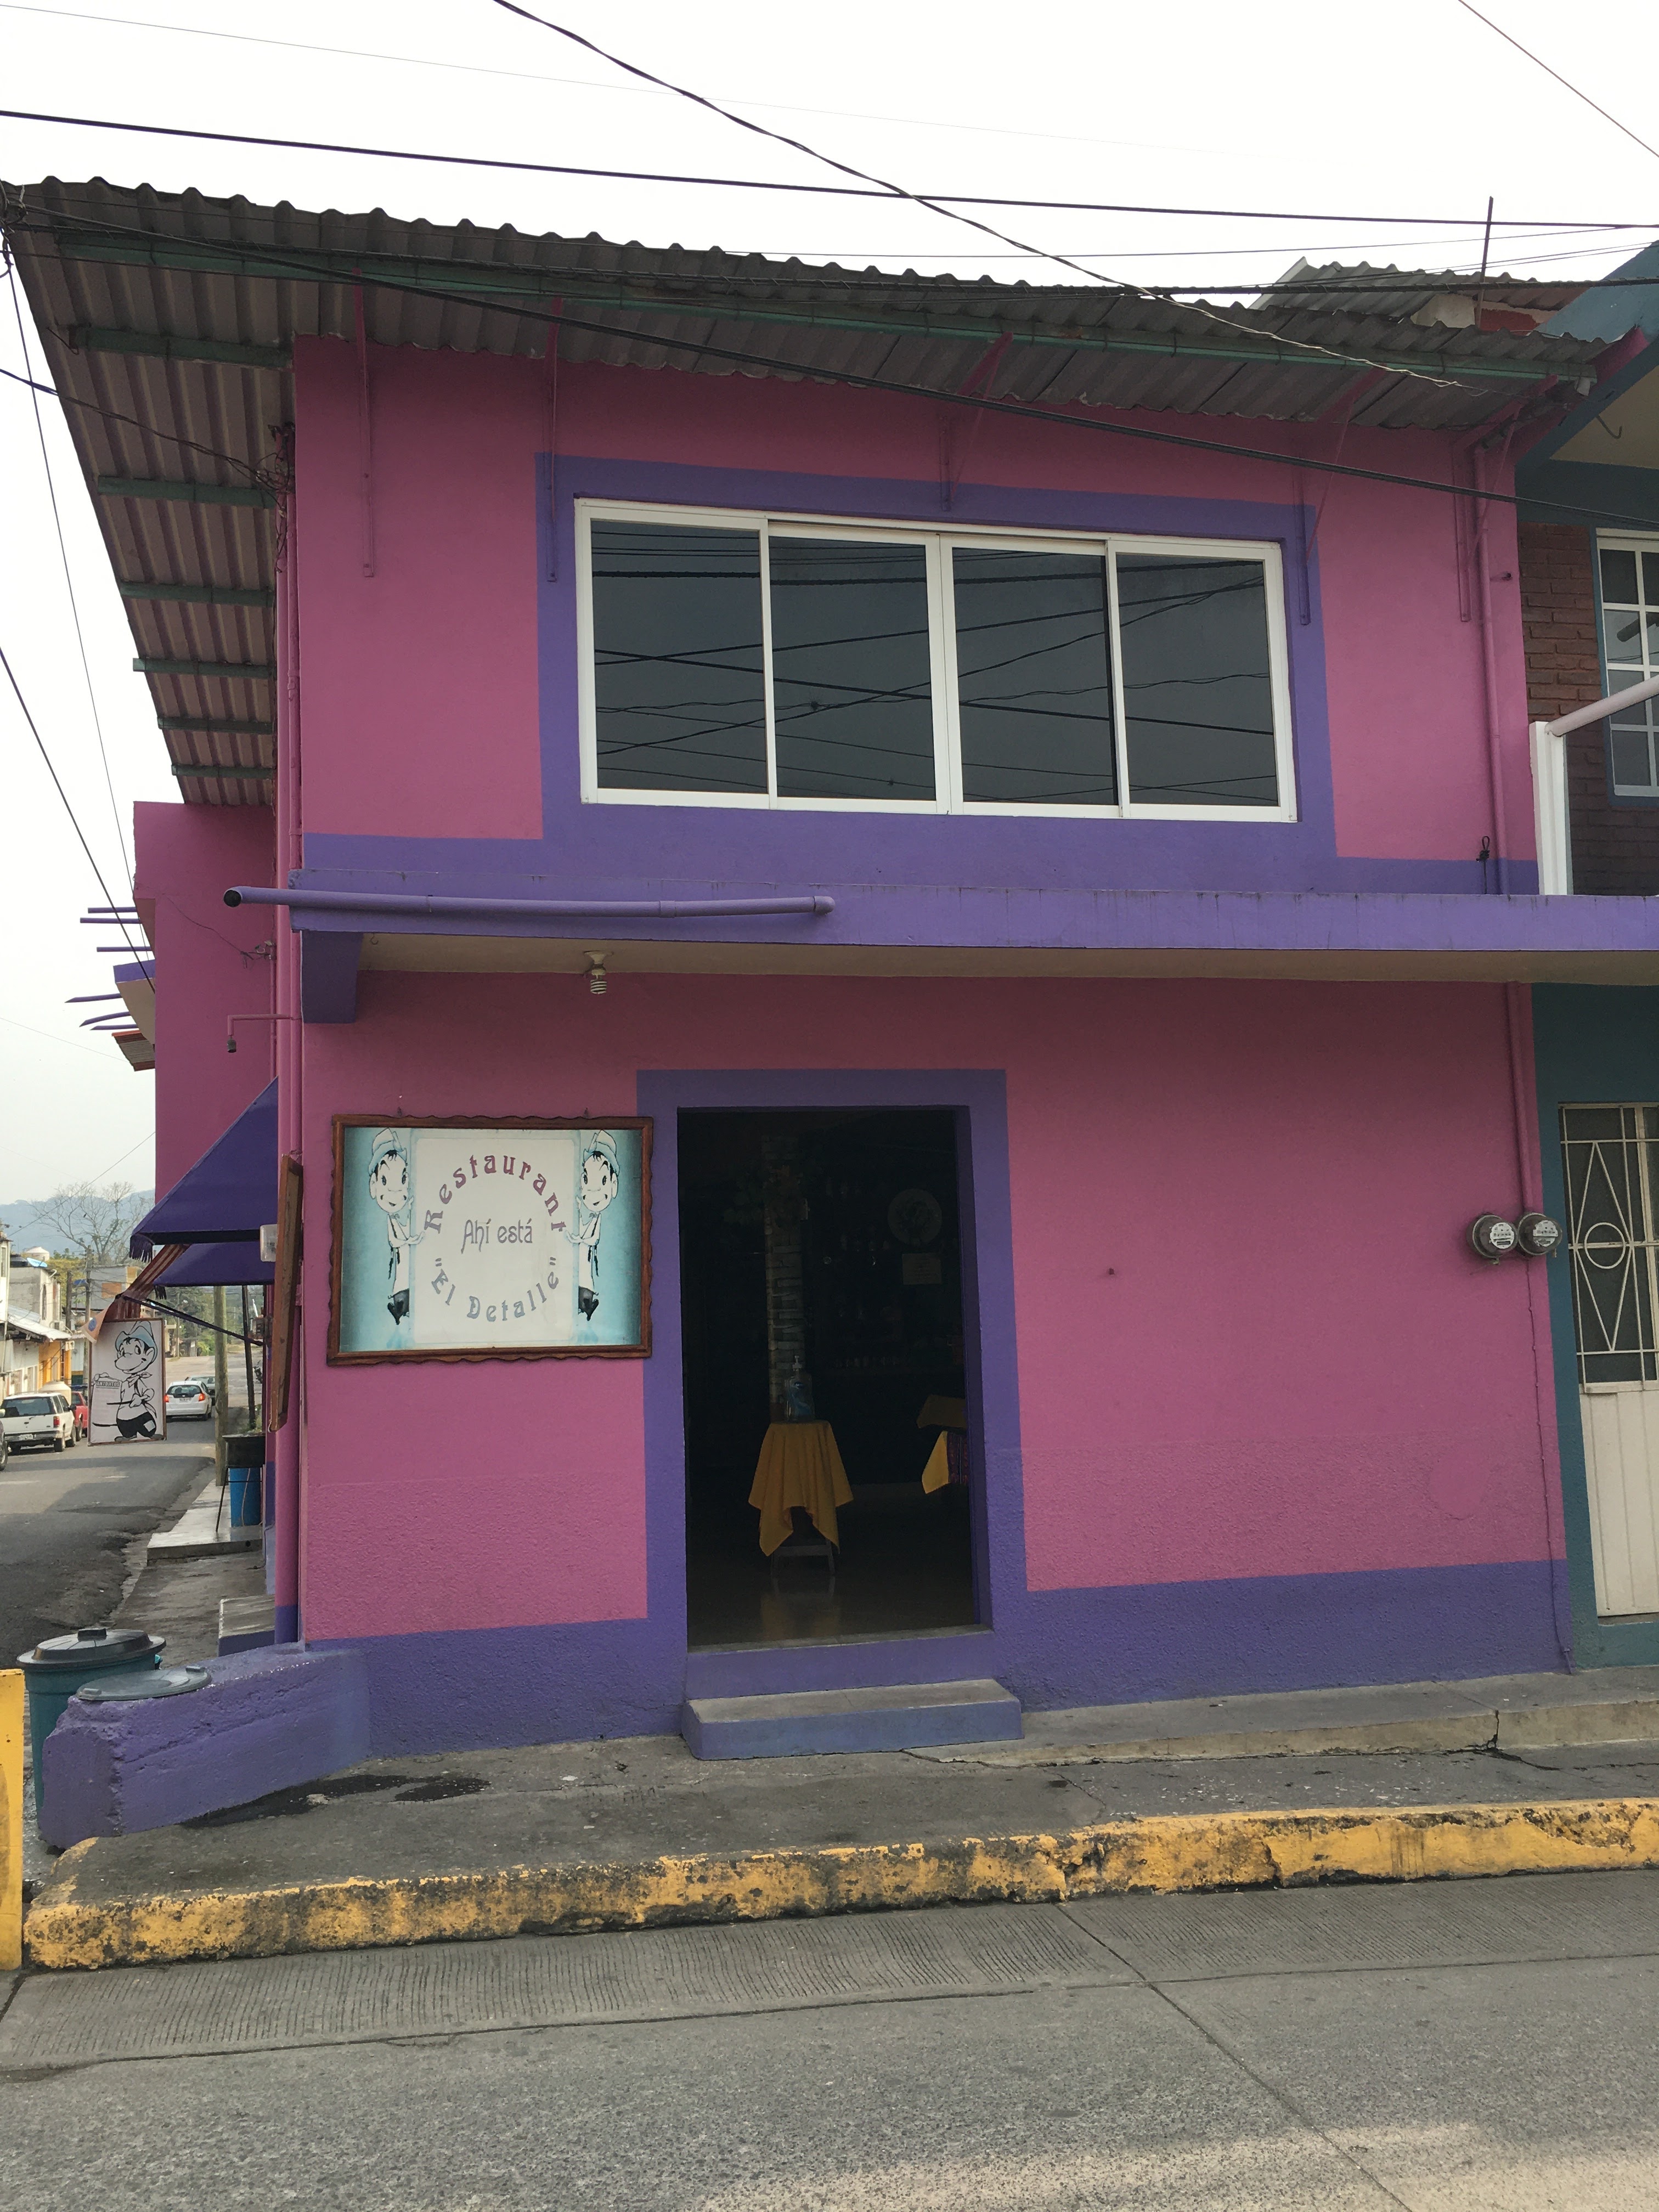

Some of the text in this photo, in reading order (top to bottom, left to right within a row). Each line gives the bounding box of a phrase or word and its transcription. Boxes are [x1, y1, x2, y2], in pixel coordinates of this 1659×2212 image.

[424, 1155, 567, 1234] Restaurant
[461, 1218, 533, 1254] Ahí está
